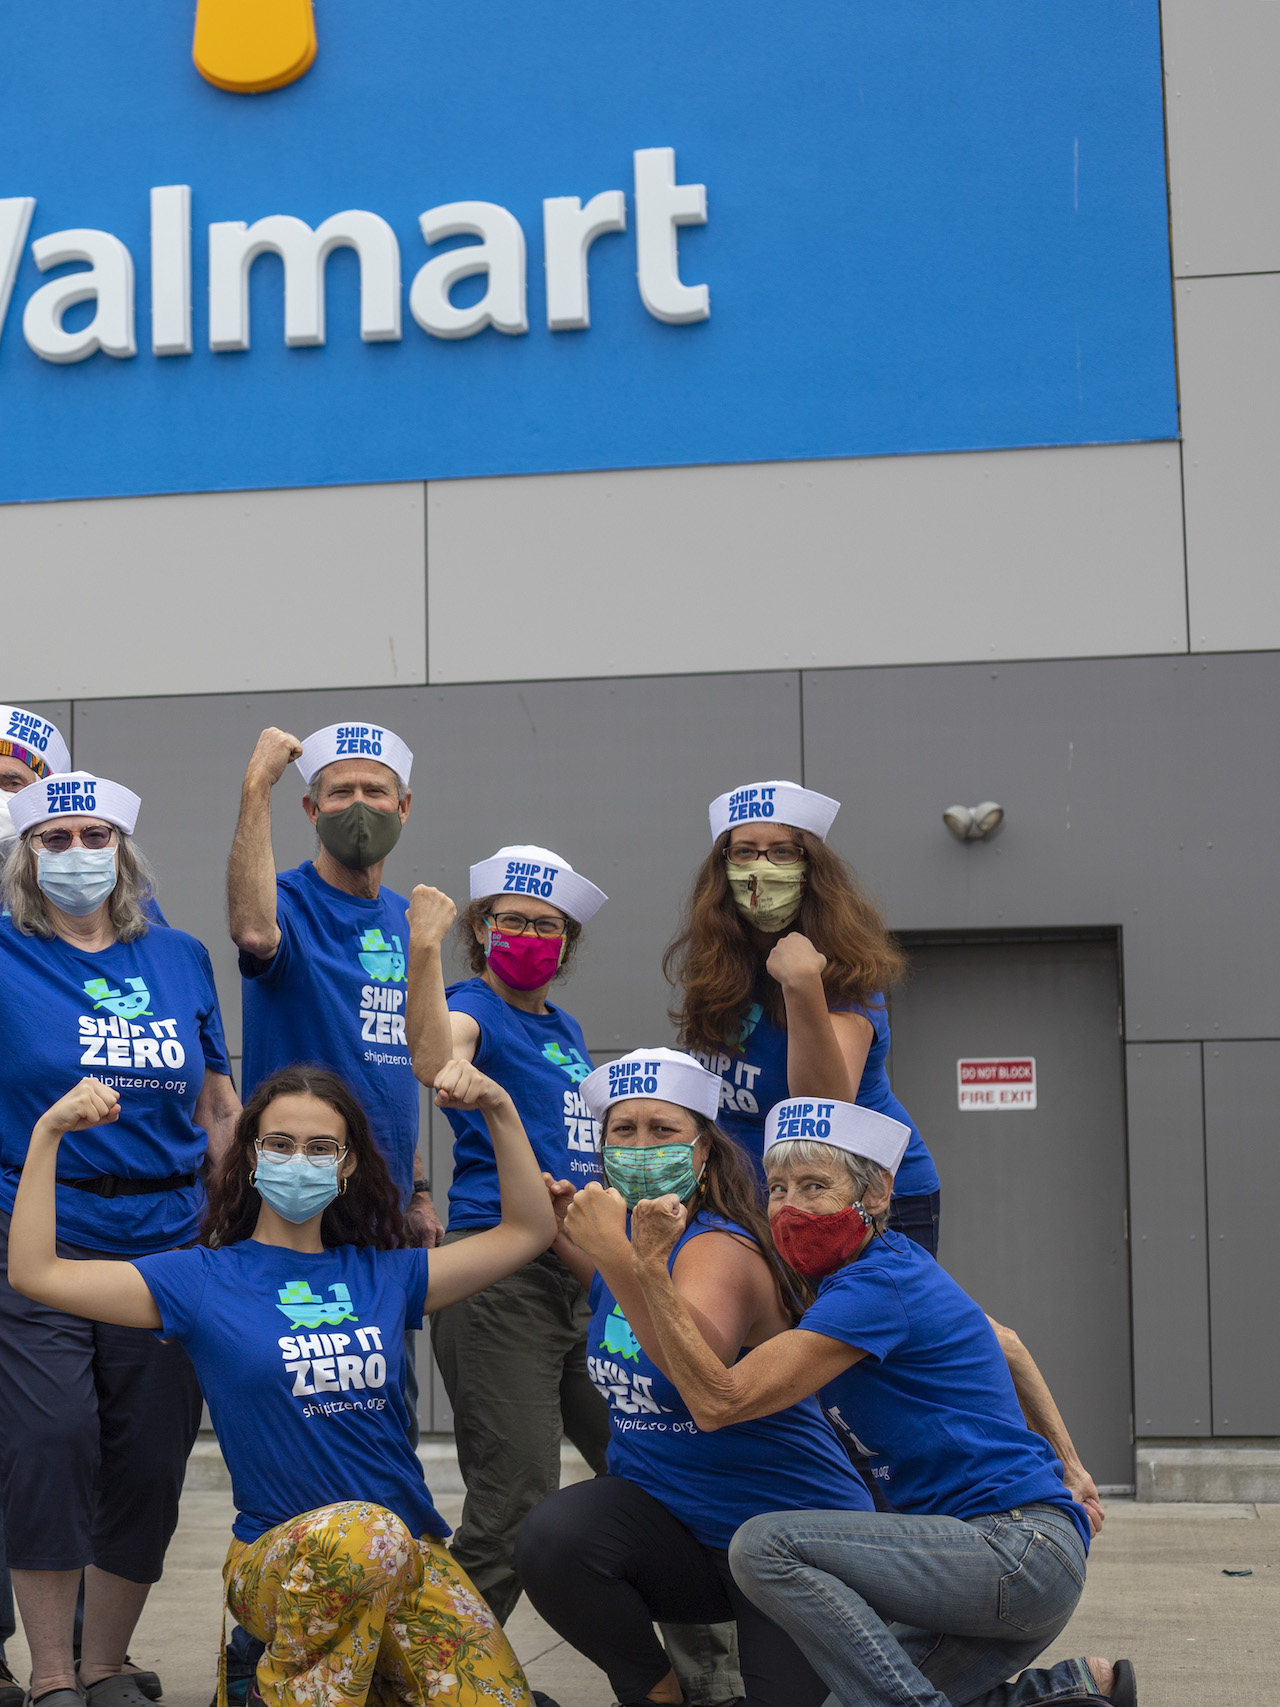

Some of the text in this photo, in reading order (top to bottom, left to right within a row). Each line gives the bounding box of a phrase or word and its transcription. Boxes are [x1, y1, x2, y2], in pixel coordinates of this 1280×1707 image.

[10, 711, 54, 738] SHIP IT
[336, 727, 384, 741] SHIP IT
[6, 721, 48, 752] ZERO
[336, 738, 382, 756] ZERO
[46, 781, 97, 796] SHIP IT
[728, 788, 776, 806] SHIP IT
[47, 794, 96, 814] ZERO
[728, 801, 775, 823] ZERO
[506, 861, 559, 882] SHIP IT
[502, 874, 553, 898] ZERO
[360, 985, 404, 1013] SHIP
[78, 1015, 178, 1038] SHIP IT
[359, 1009, 408, 1046] ZER
[79, 1036, 186, 1069] ZERO
[364, 1049, 412, 1066] shipitzero.
[609, 1062, 661, 1079] SHIP IT
[689, 1049, 762, 1090] HIP IT
[962, 1065, 1032, 1080] DO NOT BLOCK
[609, 1076, 658, 1099] ZERO
[719, 1080, 760, 1114] RO
[961, 1089, 1033, 1104] FIRE EXIT
[778, 1104, 835, 1120] SHIP IT
[564, 1116, 603, 1153] ZER
[776, 1118, 831, 1140] ZERO
[278, 1326, 383, 1360] SHIP IT
[285, 1353, 387, 1397] ZERO
[633, 1373, 654, 1401] IT
